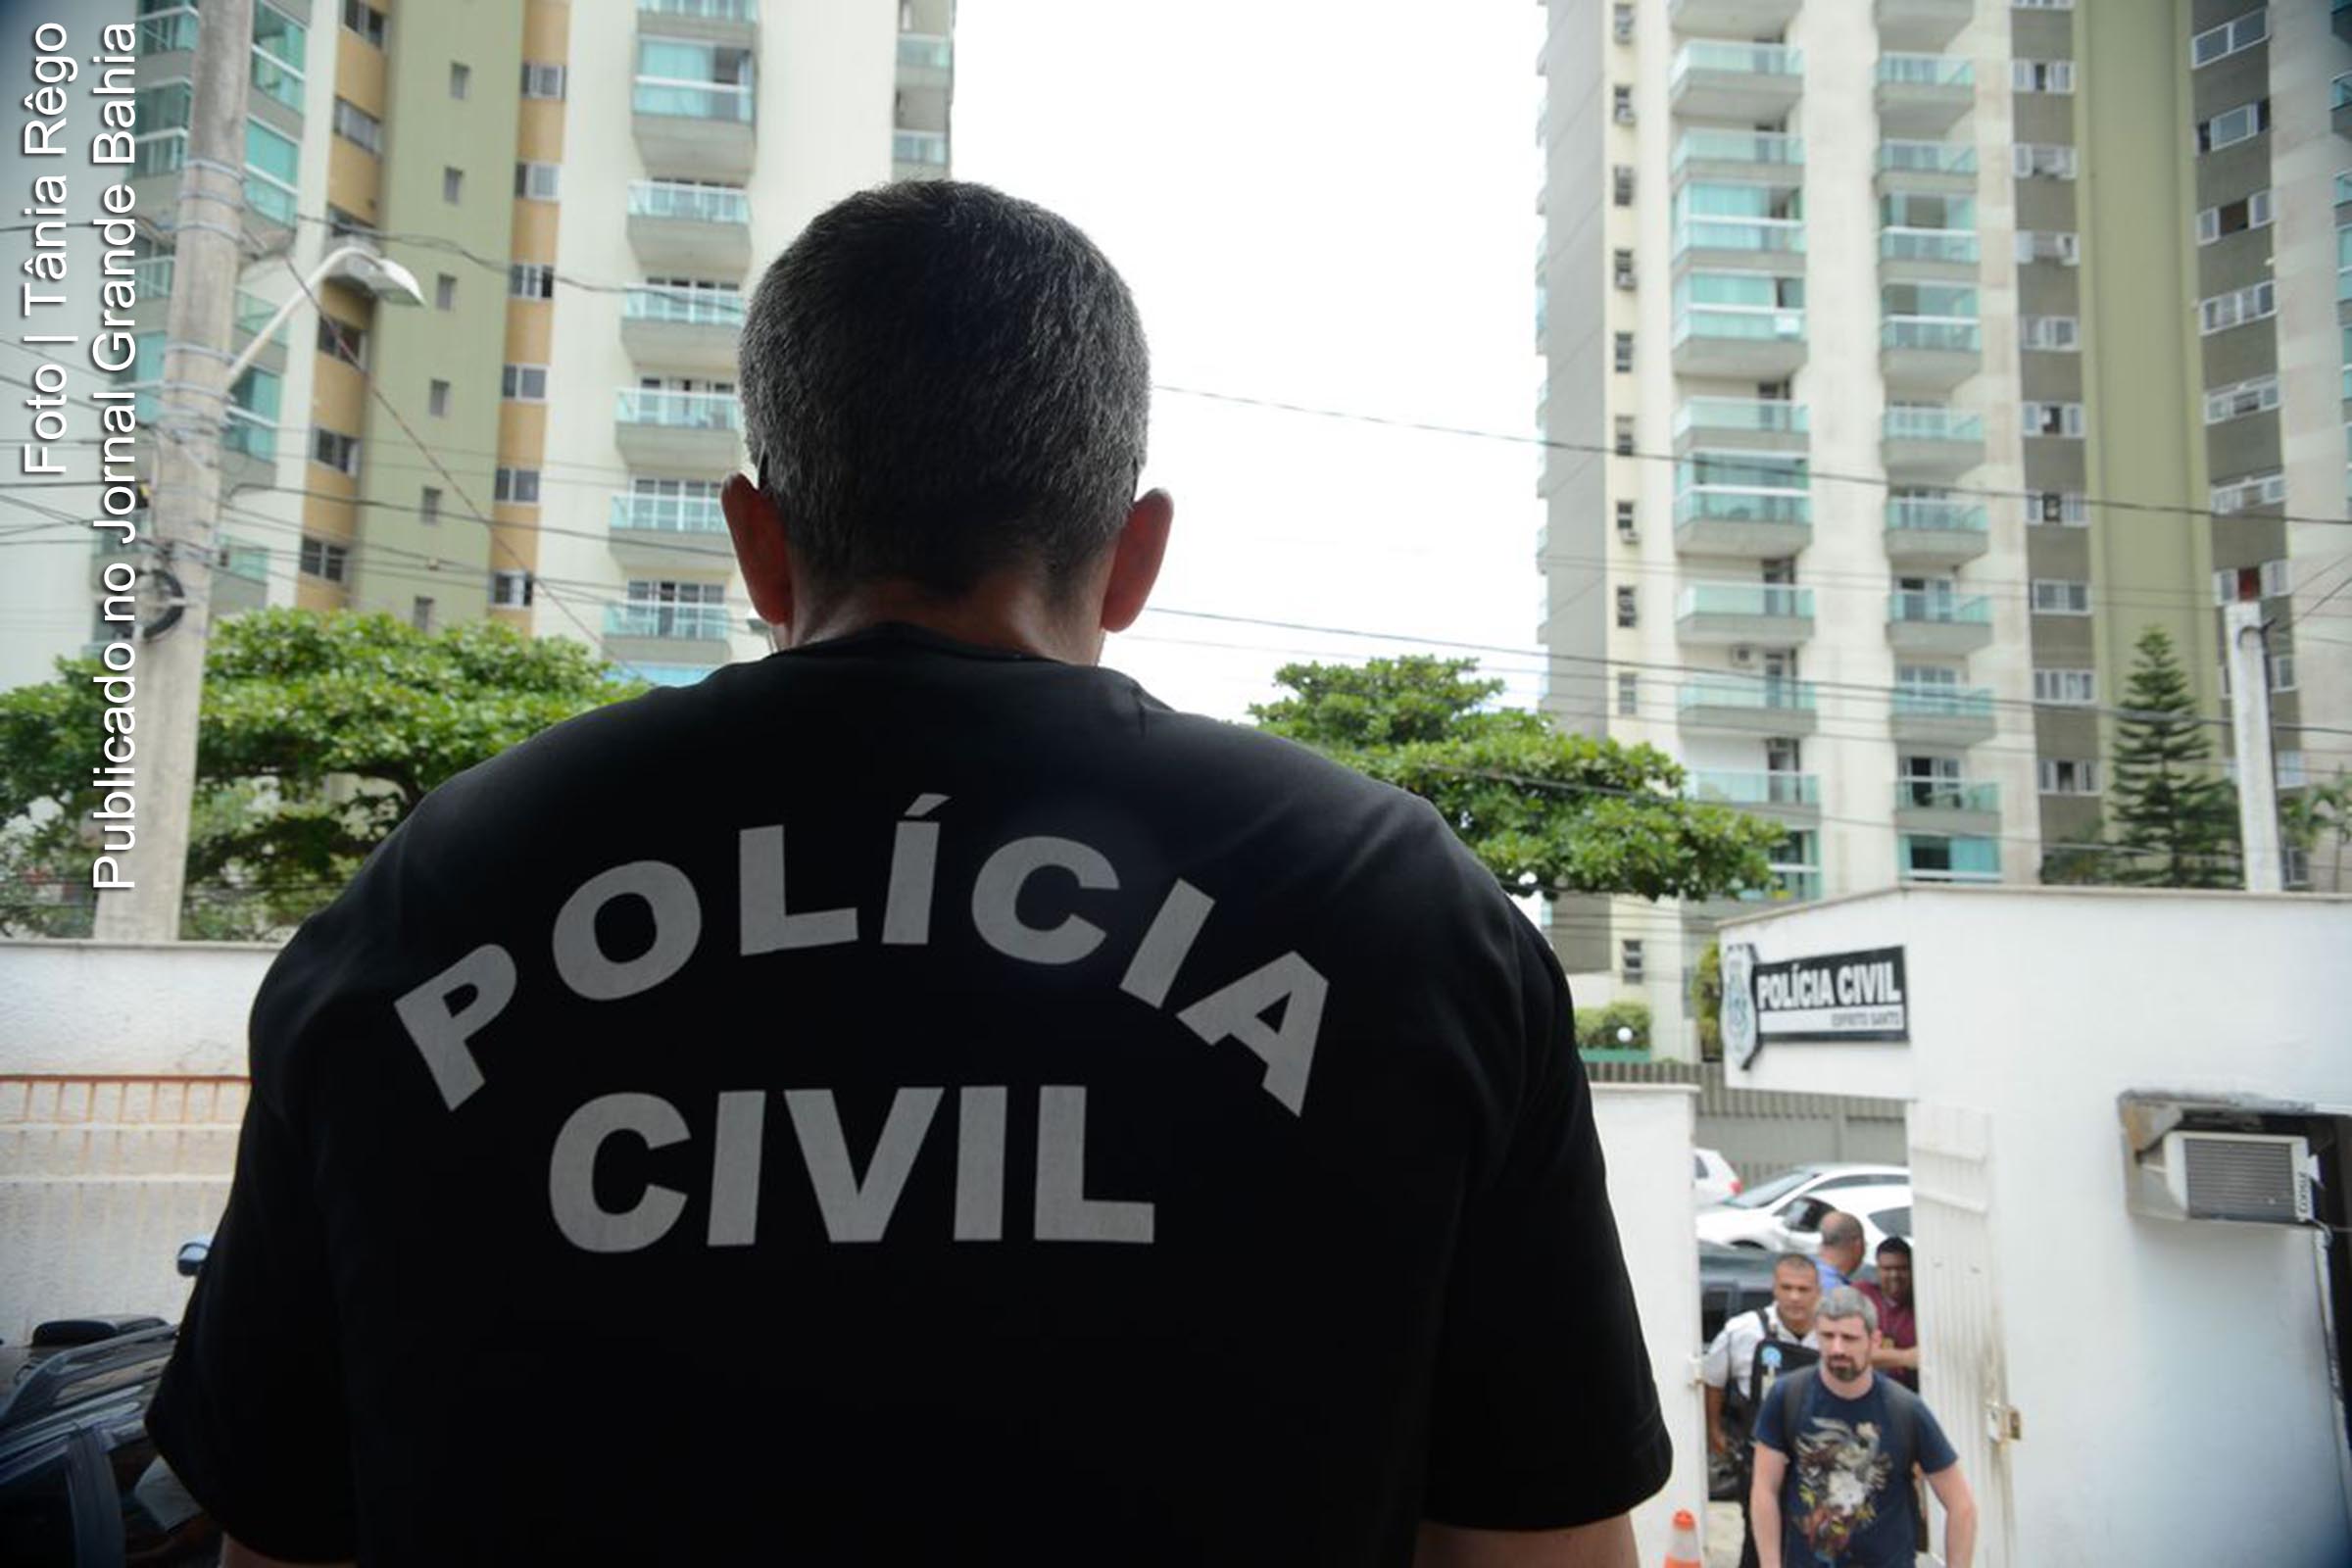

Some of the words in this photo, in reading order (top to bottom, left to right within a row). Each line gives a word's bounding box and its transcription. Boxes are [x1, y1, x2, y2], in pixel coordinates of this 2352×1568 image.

[394, 792, 1329, 1116] POLÍCIA
[1756, 962, 1835, 1010] POLÍCIA
[1837, 961, 1901, 1005] CIVIL
[550, 1085, 1156, 1251] CIVIL
